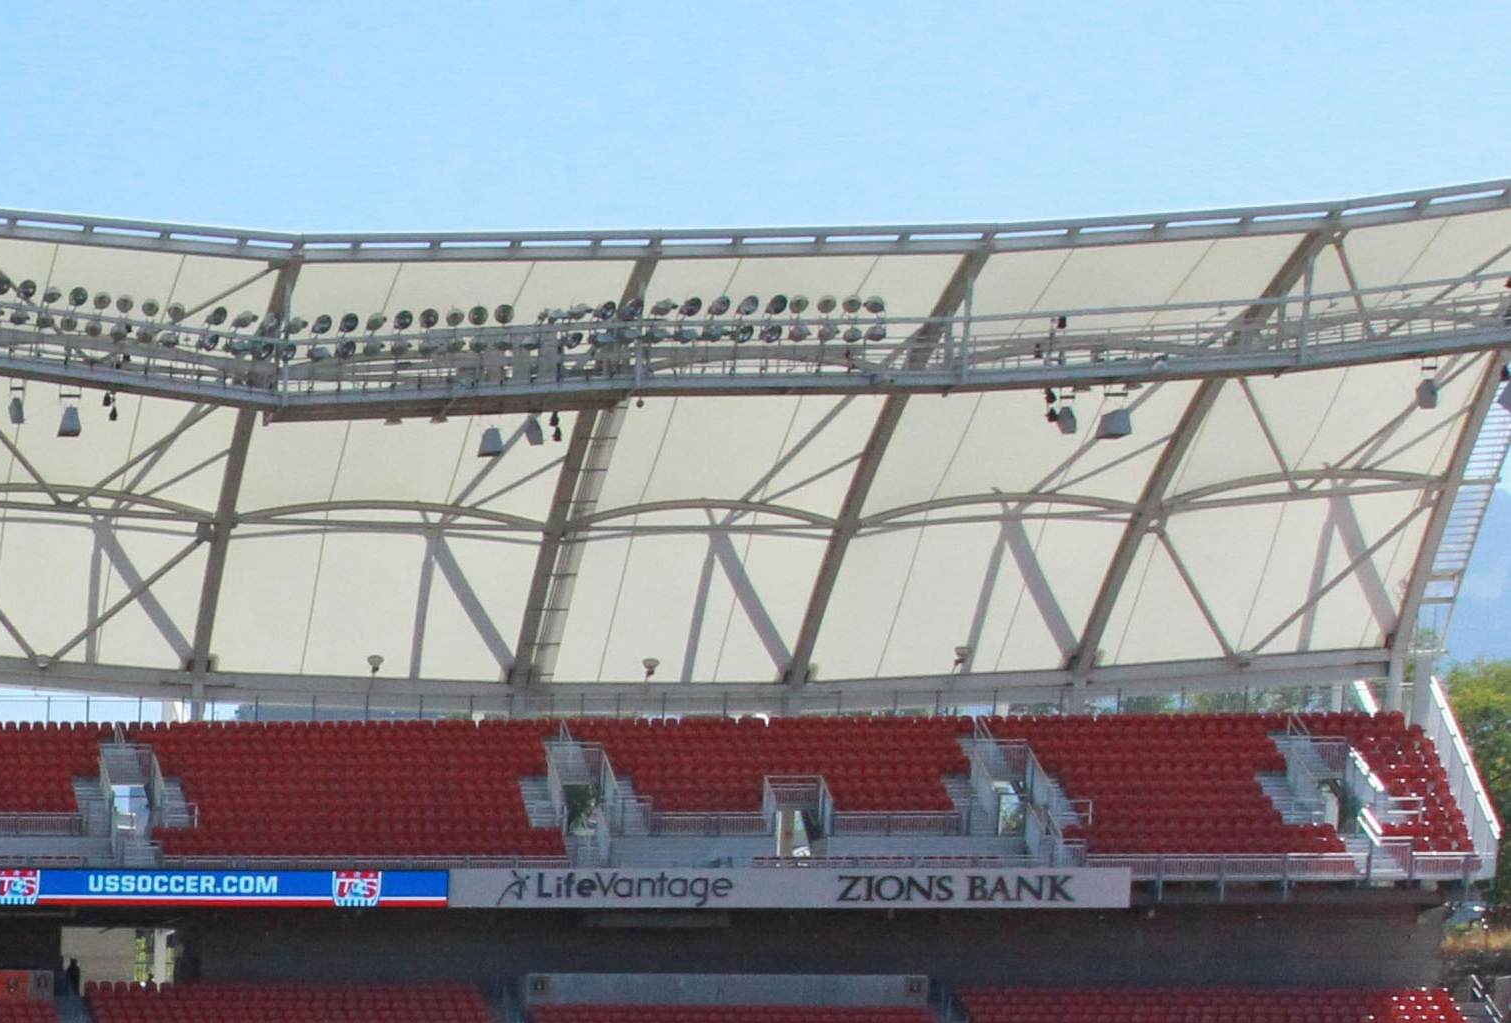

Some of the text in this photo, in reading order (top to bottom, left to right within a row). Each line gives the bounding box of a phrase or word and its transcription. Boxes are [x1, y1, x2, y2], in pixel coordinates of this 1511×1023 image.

[89, 874, 278, 894] USSOCCER.COM
[537, 871, 734, 907] LifeVantage
[837, 874, 1076, 901] ZIONS BANK
